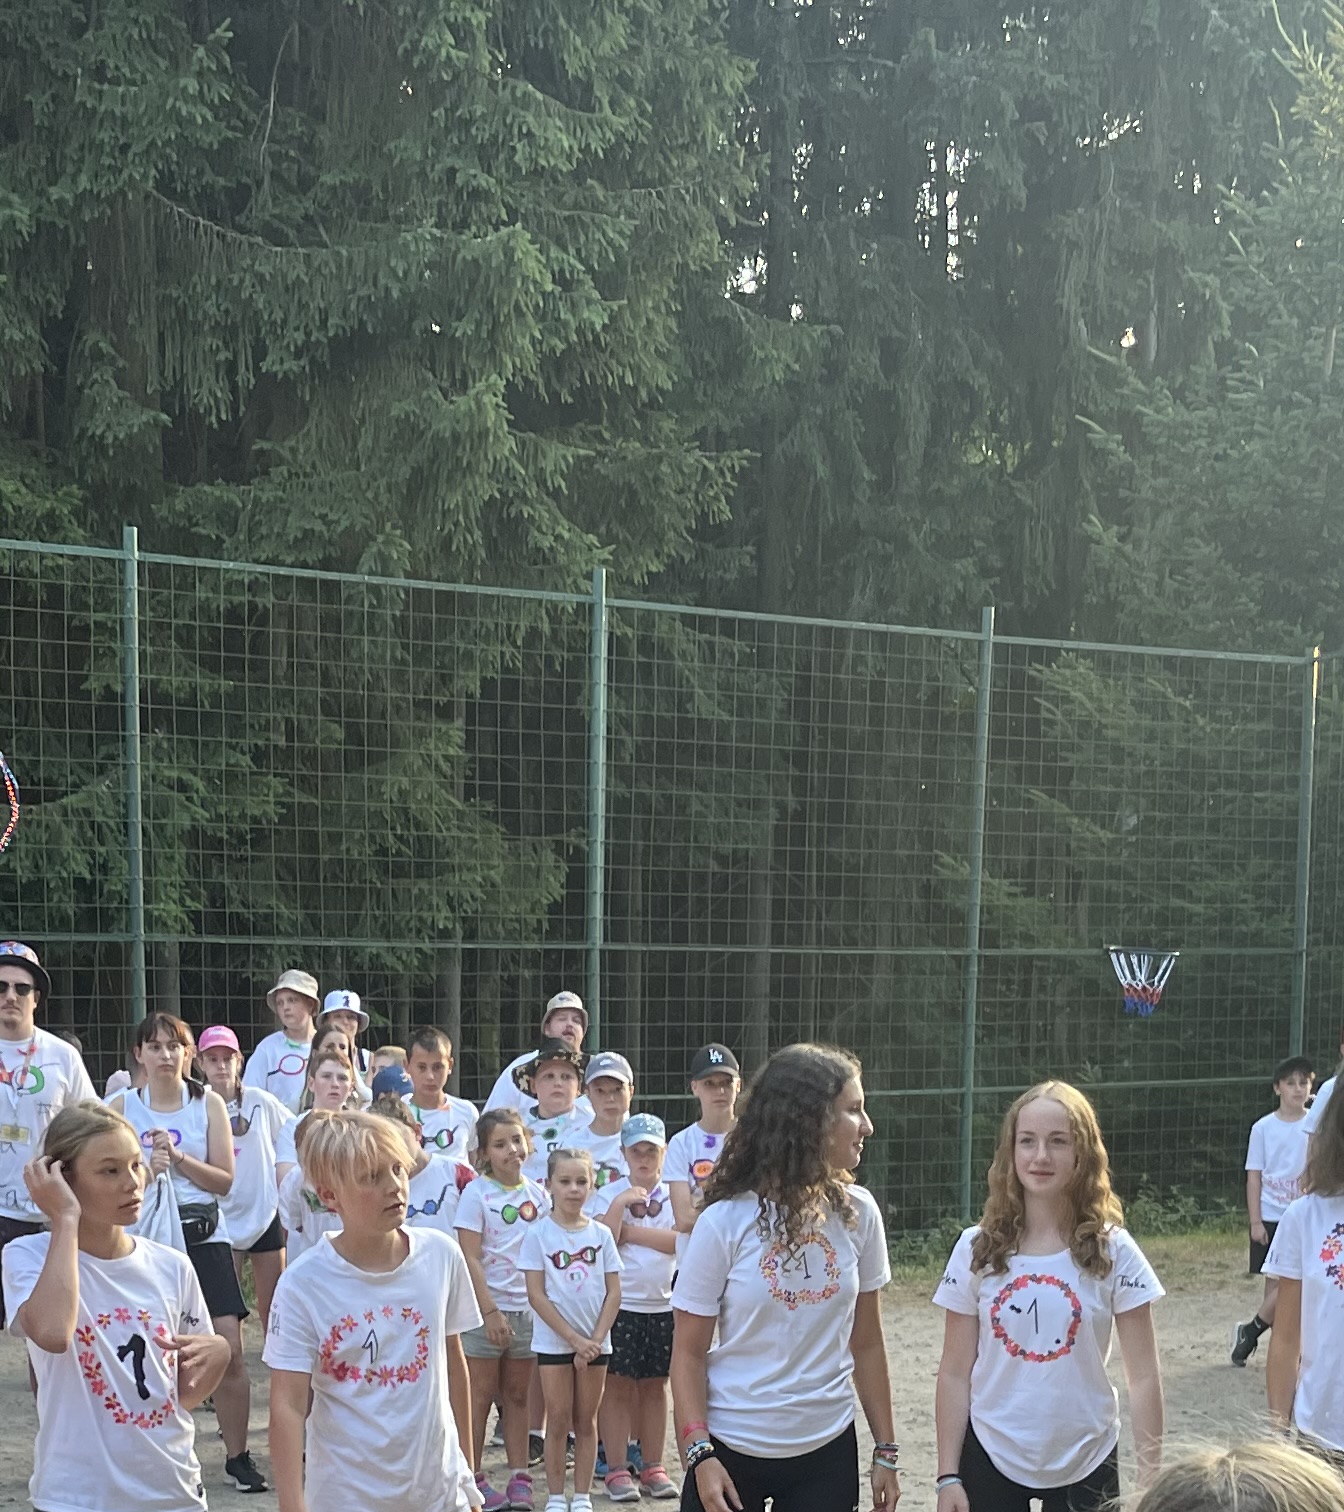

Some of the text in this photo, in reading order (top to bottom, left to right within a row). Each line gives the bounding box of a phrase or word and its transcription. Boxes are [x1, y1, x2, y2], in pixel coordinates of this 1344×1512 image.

[709, 1048, 723, 1064] LA
[1026, 1298, 1039, 1335] 1
[361, 1328, 379, 1365] 1
[116, 1333, 151, 1401] 1
